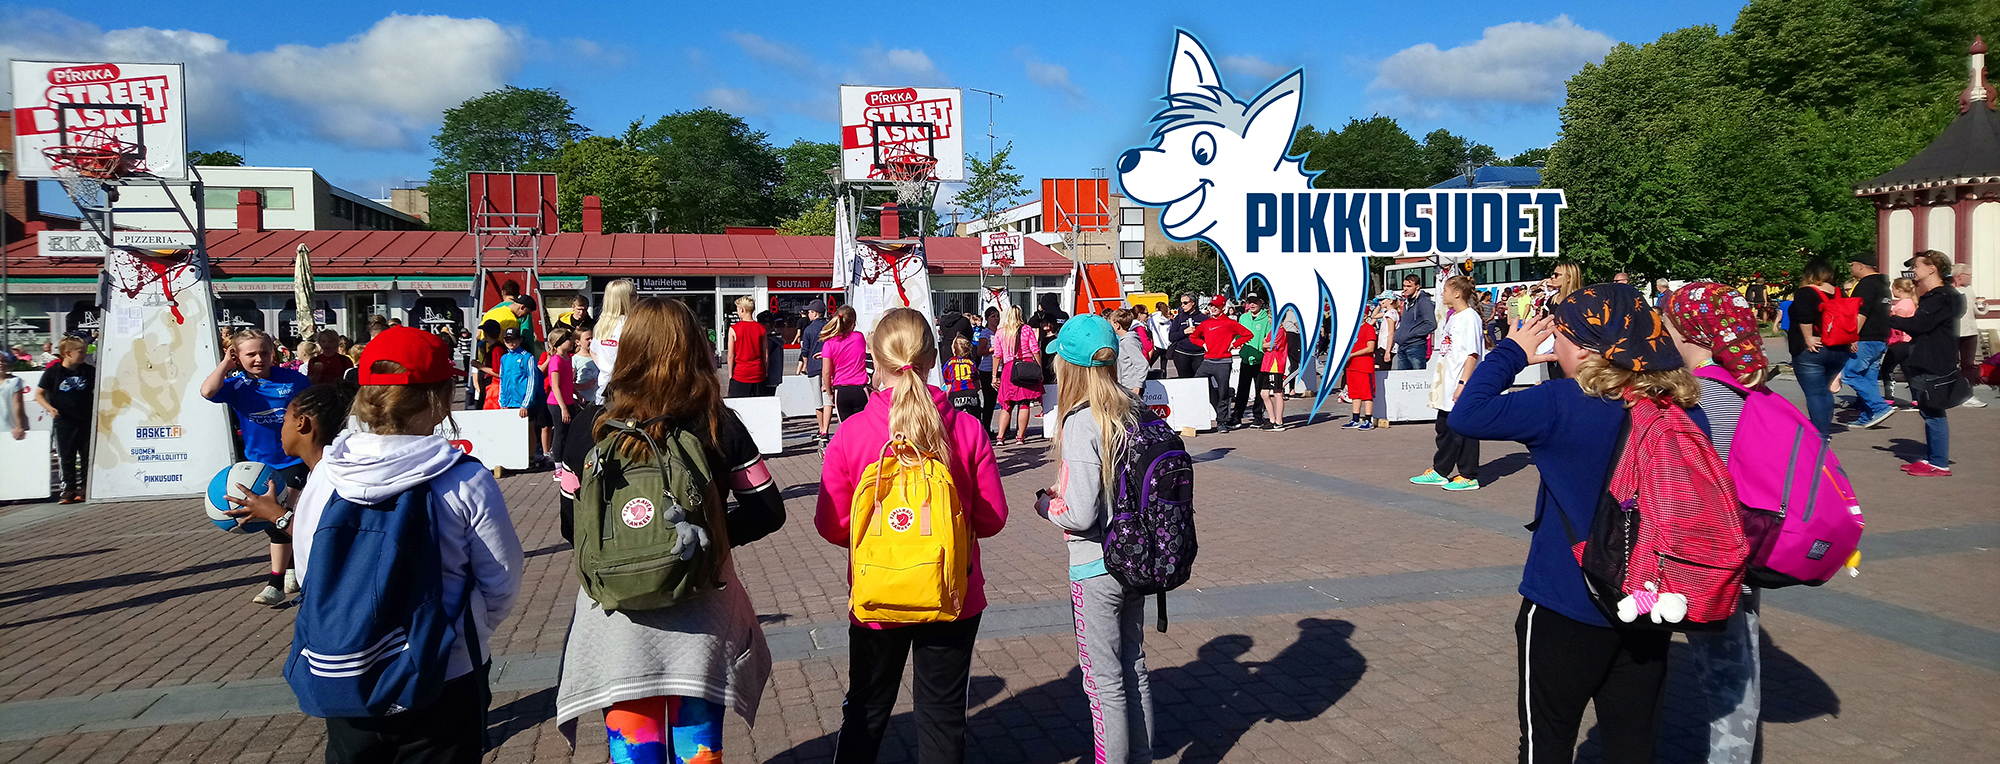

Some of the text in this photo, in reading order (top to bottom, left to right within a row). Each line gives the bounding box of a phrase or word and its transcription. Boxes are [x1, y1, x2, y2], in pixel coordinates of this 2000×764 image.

[49, 79, 166, 108] STREET
[865, 100, 950, 123] STREET
[33, 103, 164, 132] BASKET
[855, 121, 948, 146] BASKET
[49, 236, 173, 252] EKA PIZZERIA
[990, 236, 1019, 246] STREET
[356, 282, 379, 290] EKA
[410, 281, 432, 289] EKA
[553, 281, 574, 289] EKA
[643, 278, 687, 286] MariHelena
[776, 280, 810, 288] SUUTARI
[954, 363, 972, 381] 10
[1401, 382, 1423, 392] Hyvät
[136, 427, 182, 438] BASKET.FI
[144, 474, 183, 482] PIKKUSUDET
